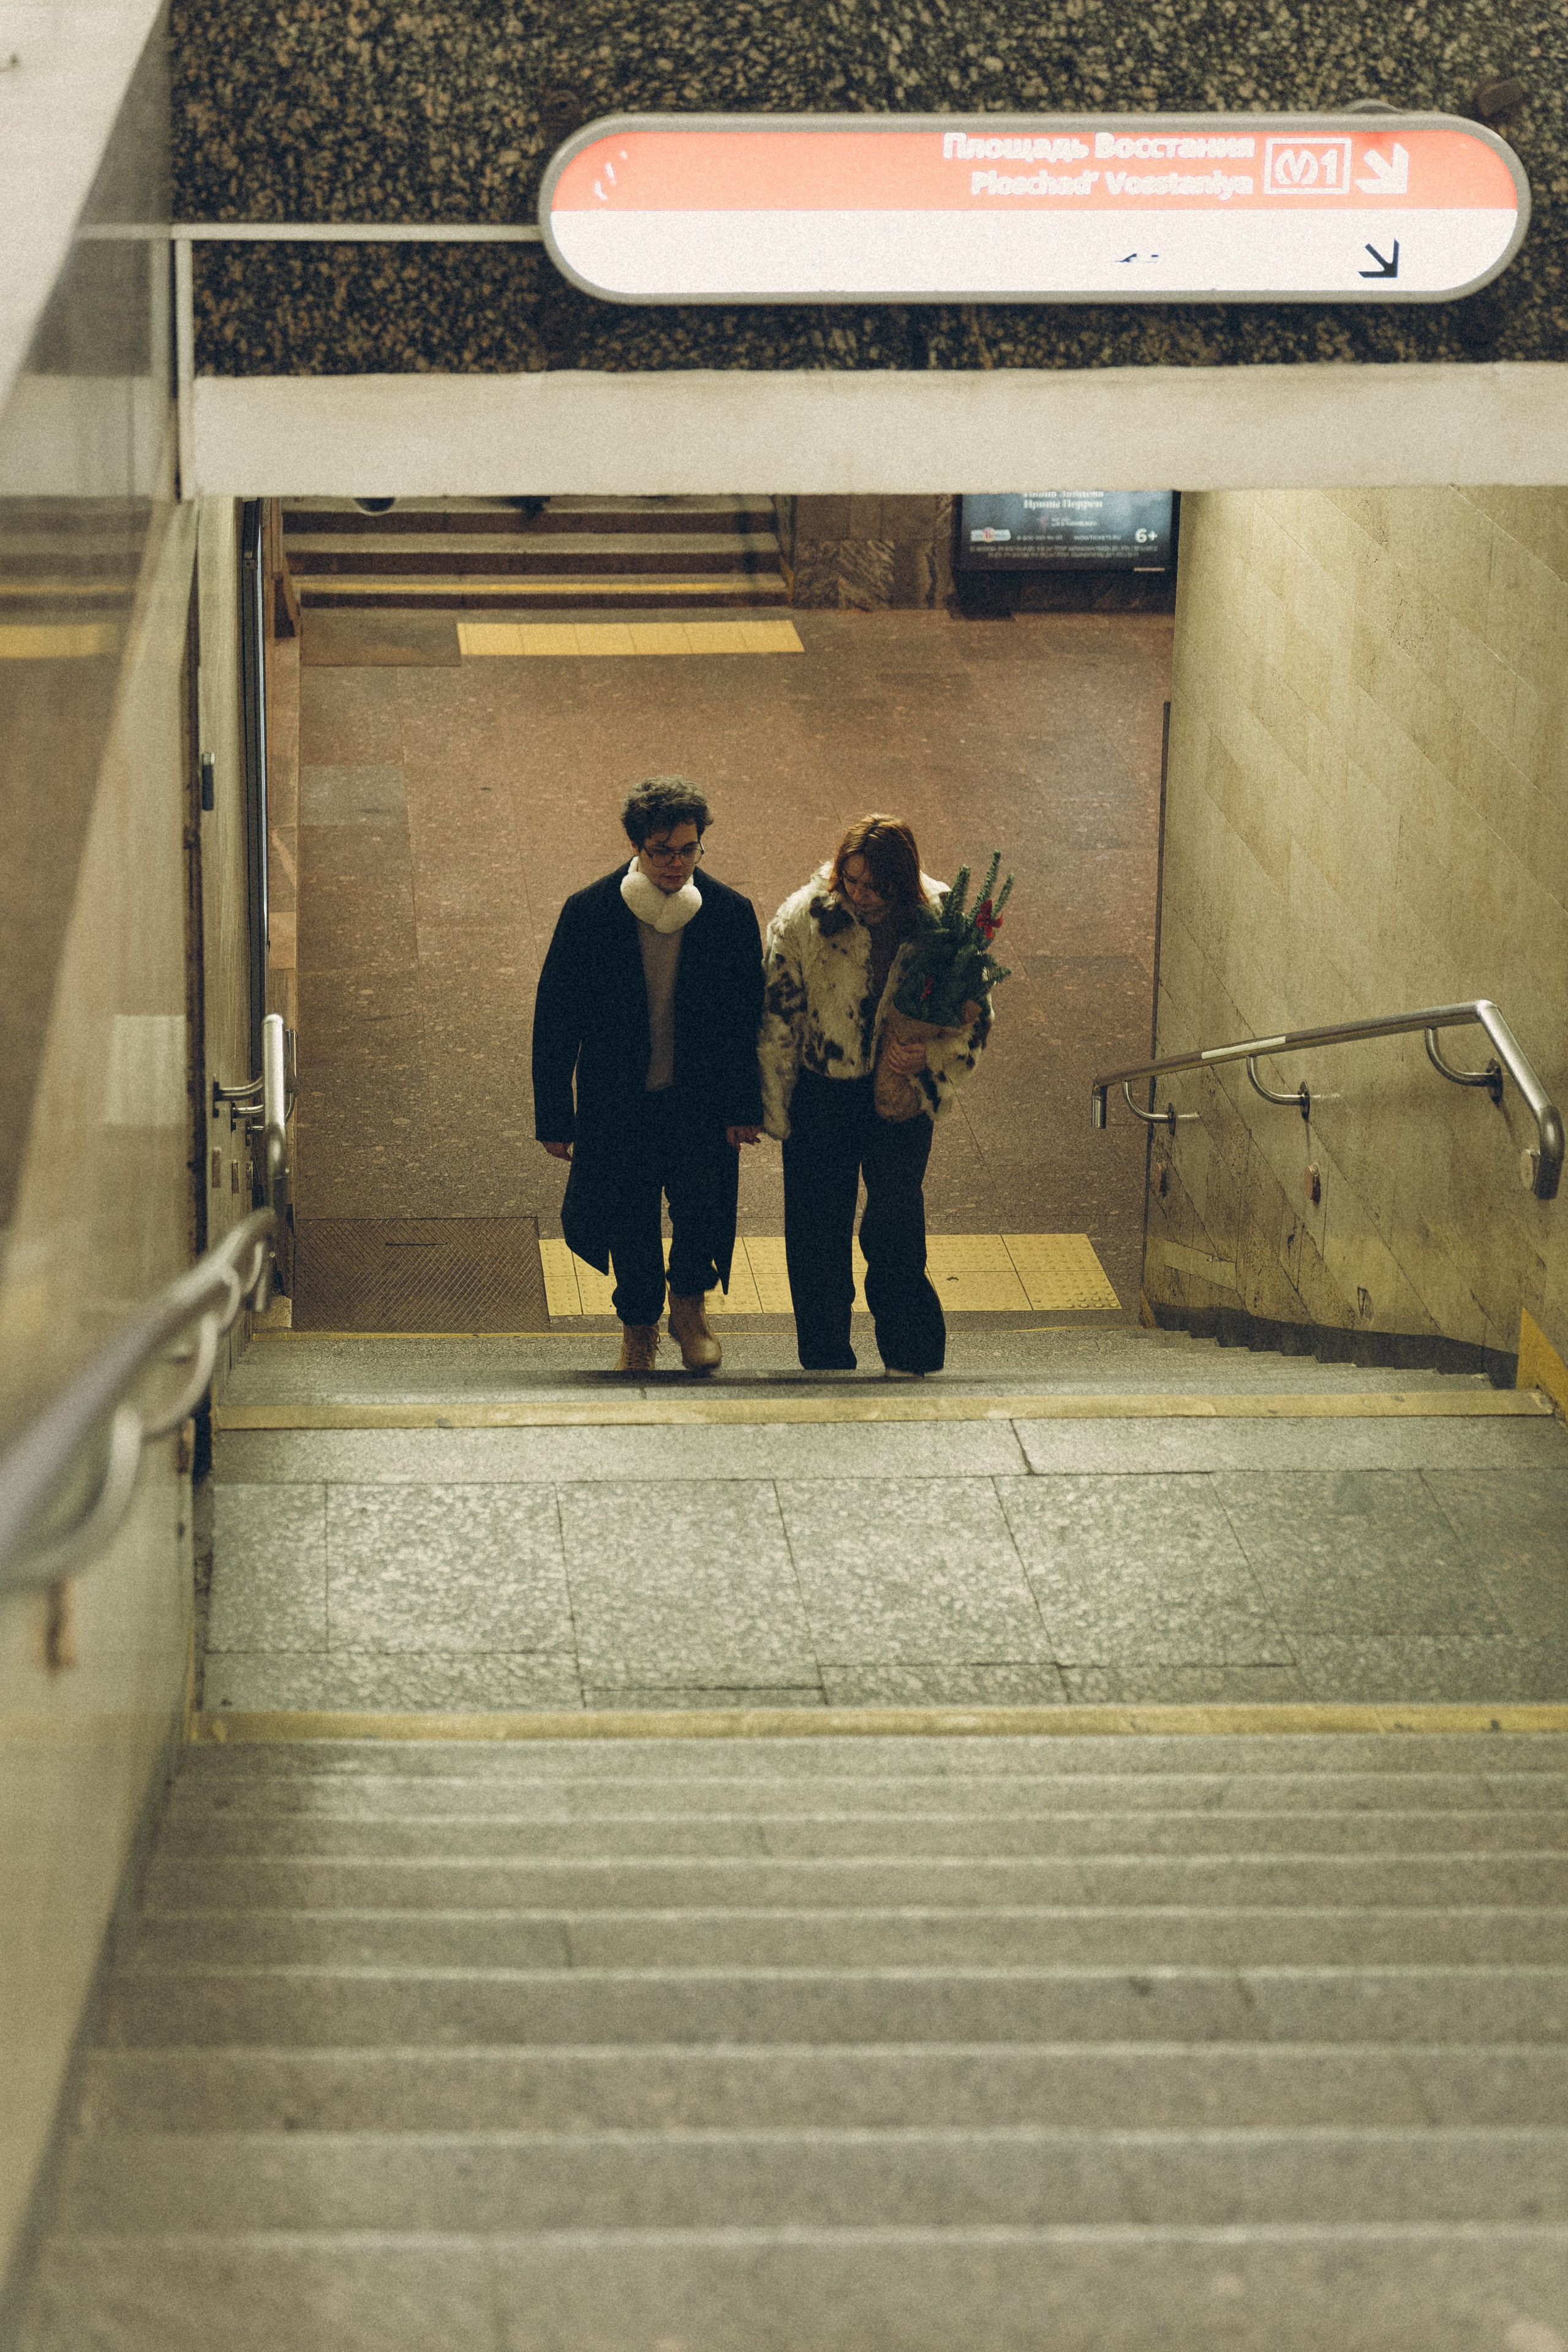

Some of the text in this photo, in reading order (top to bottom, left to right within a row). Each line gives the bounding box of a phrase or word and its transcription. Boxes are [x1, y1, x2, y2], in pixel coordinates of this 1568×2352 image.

[943, 132, 1256, 163] Площадь Восстания
[1103, 169, 1254, 201] Vosstaniya
[1134, 527, 1158, 544] 6+
